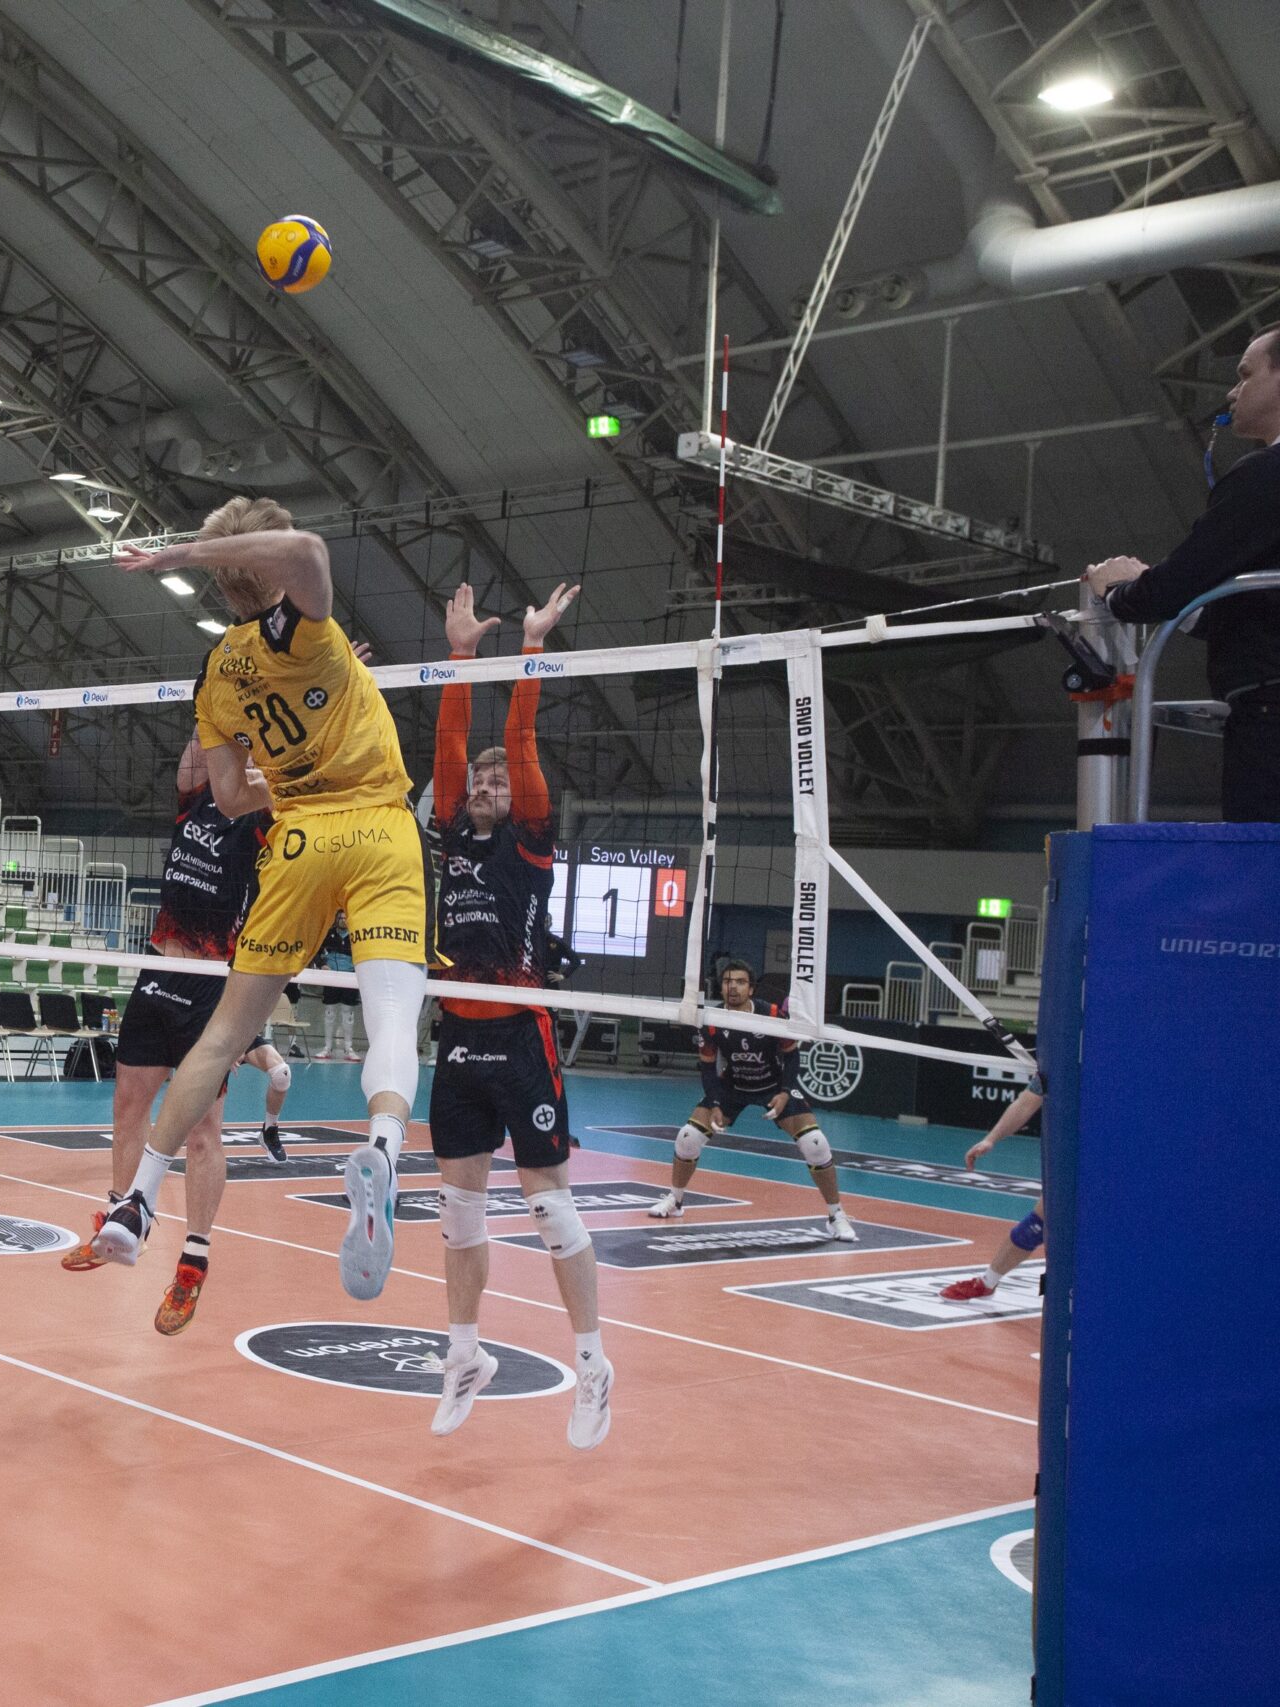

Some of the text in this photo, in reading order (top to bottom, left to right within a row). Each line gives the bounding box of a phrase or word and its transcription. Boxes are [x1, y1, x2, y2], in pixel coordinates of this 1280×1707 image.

[244, 692, 308, 758] 20
[795, 696, 815, 796] SAVO VOLLEY
[591, 846, 675, 868] Savo Volley
[662, 880, 679, 908] 0
[602, 888, 619, 938] 1
[796, 882, 816, 984] SAVO VOLLEY
[801, 1072, 851, 1097] VOLLEY
[971, 1085, 1016, 1103] KUM
[283, 1336, 440, 1359] forenom
